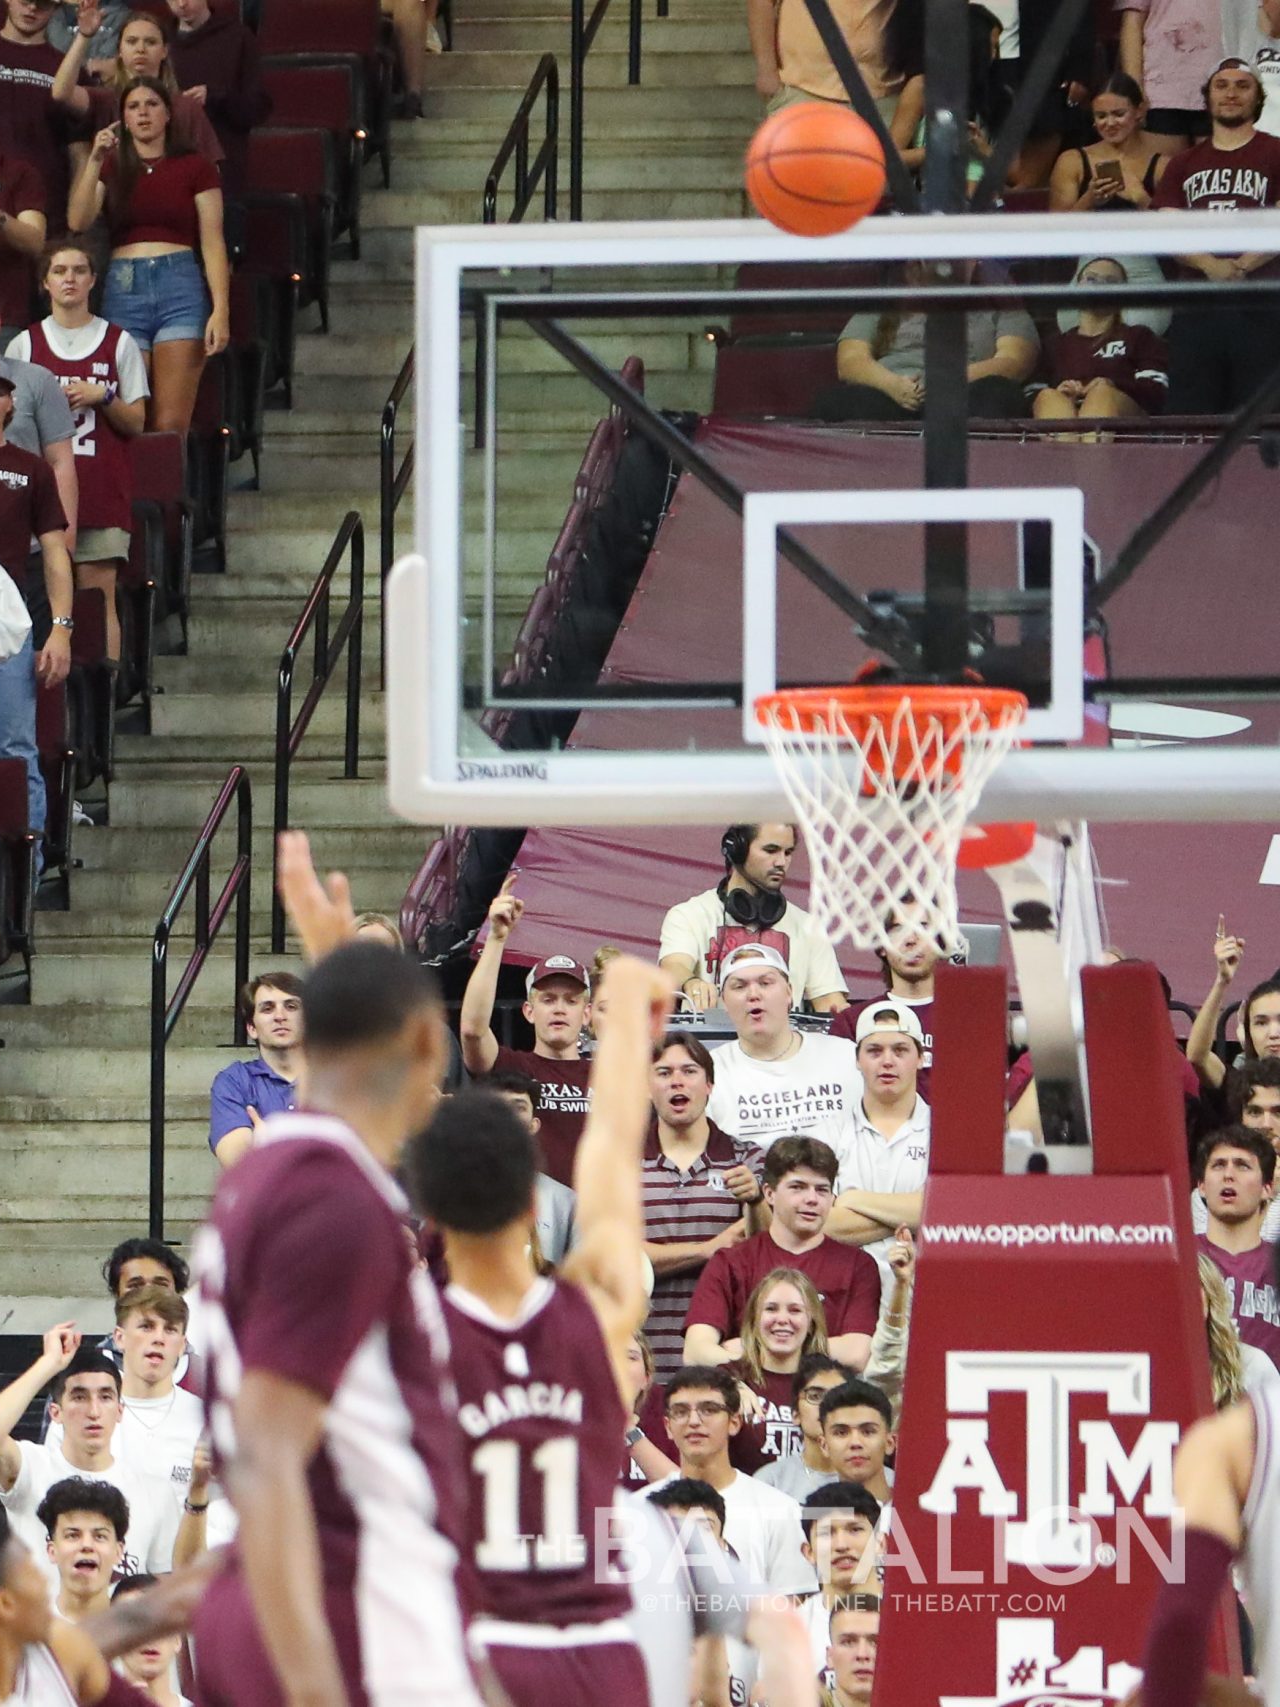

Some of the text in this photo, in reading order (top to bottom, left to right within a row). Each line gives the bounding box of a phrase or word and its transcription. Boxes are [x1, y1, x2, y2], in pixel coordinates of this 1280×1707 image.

[1182, 168, 1268, 209] TEXAS A&M
[457, 761, 548, 781] SPALDING
[737, 1083, 843, 1106] AGGIELAND
[738, 1098, 844, 1120] OUTFITTERS
[921, 1222, 1174, 1248] www.opportune.com
[458, 1382, 583, 1438] GARCIA
[472, 1436, 587, 1571] 11
